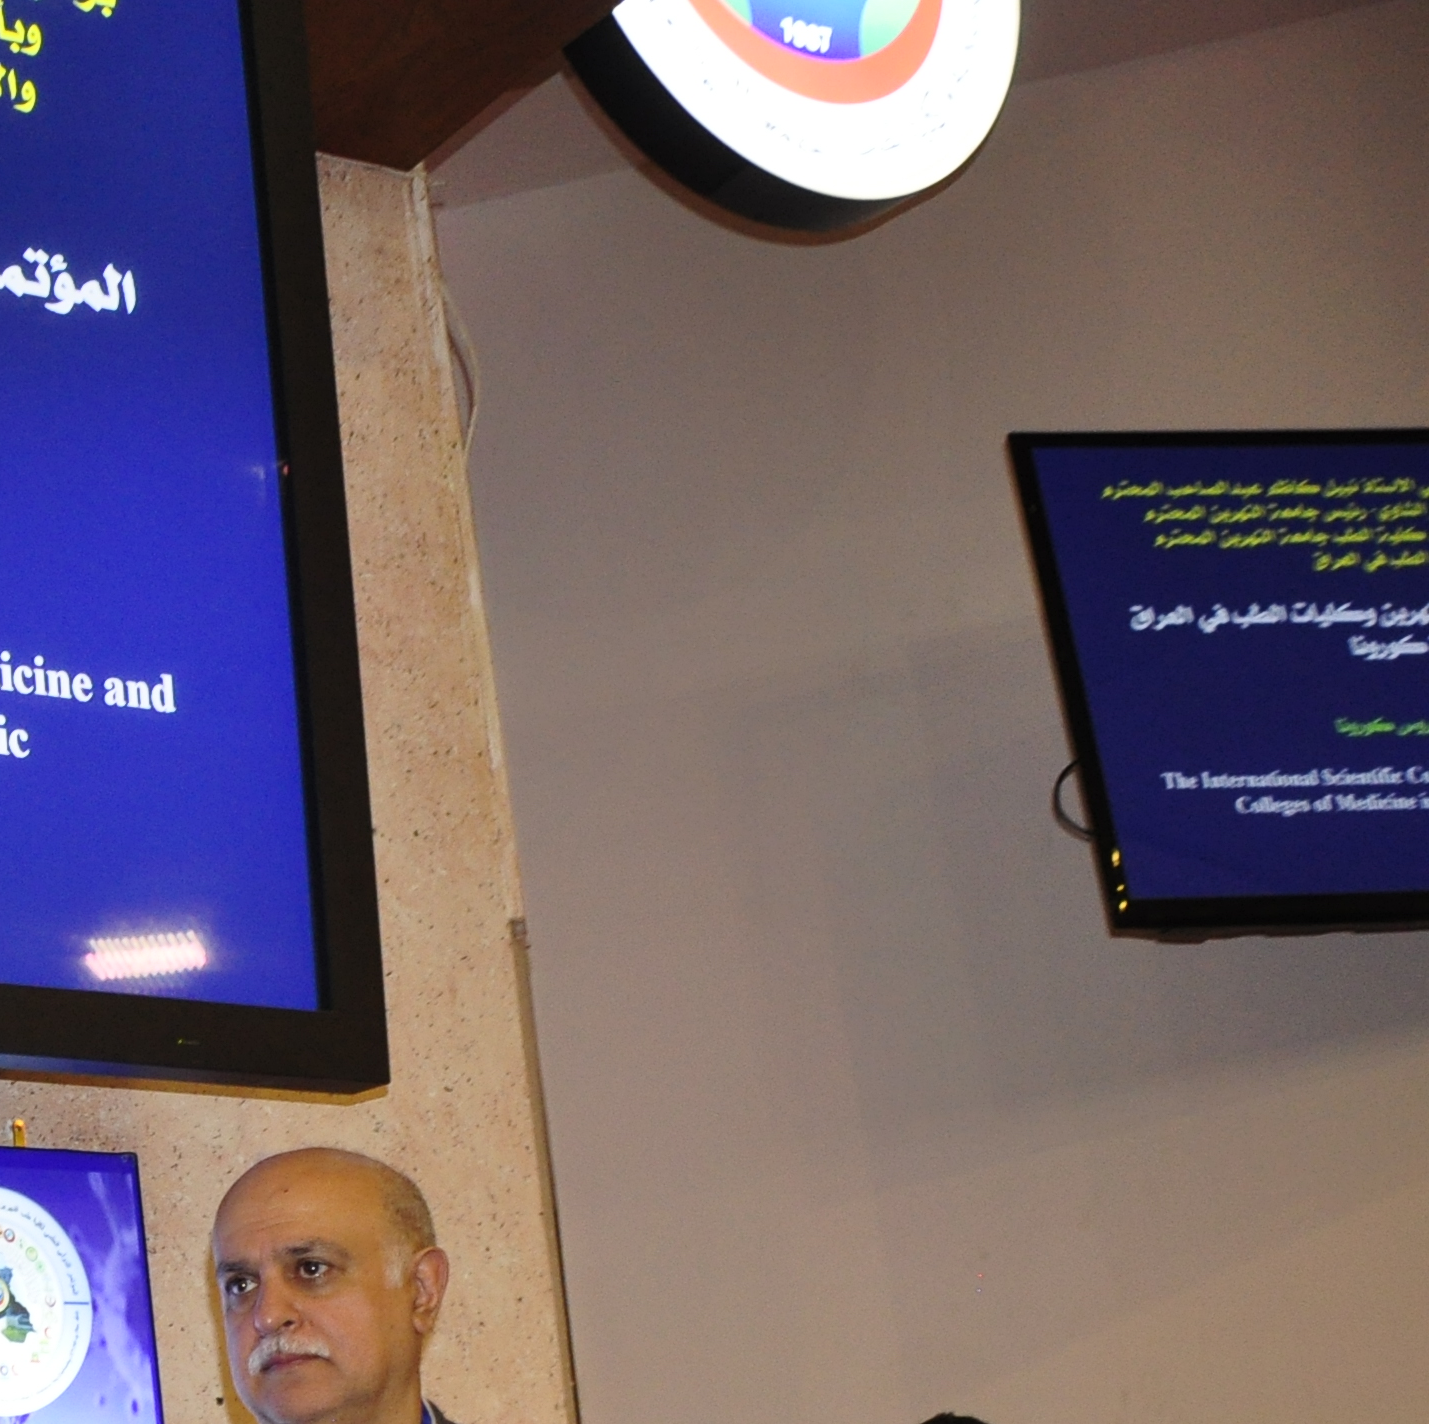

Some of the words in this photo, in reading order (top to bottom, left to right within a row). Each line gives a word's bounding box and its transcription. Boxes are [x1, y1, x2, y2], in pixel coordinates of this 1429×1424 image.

[103, 673, 175, 716] and
[1160, 772, 1198, 789] The
[1201, 769, 1319, 789] International
[1320, 766, 1403, 786] Scientific
[1235, 796, 1311, 817] Colleges
[1312, 794, 1333, 812] of
[1335, 793, 1418, 812] Medicine
